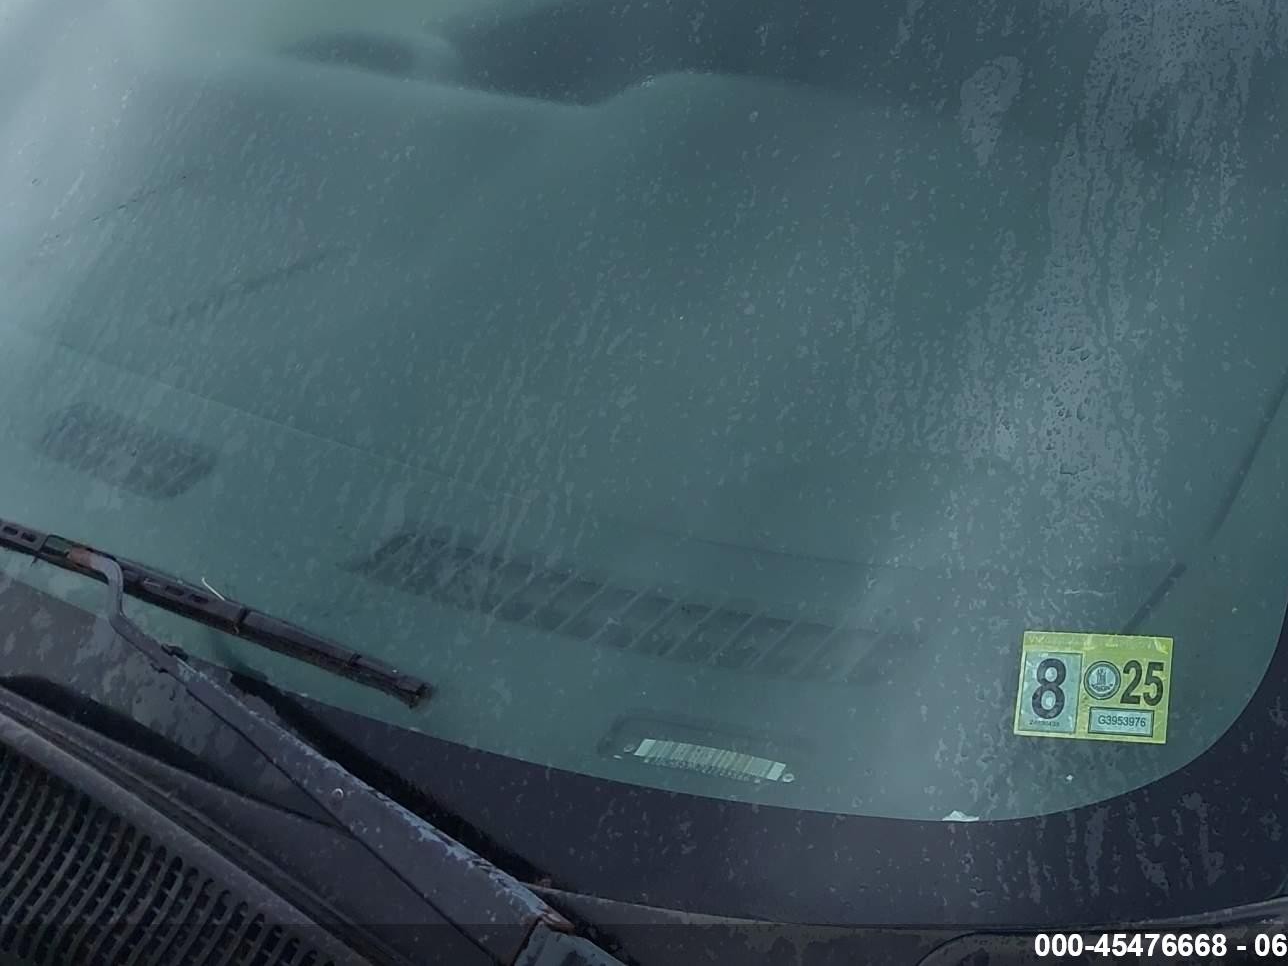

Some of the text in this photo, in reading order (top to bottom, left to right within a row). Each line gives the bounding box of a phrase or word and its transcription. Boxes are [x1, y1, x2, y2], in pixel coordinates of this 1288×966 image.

[1032, 658, 1067, 720] 8
[1120, 659, 1165, 707] 25
[1097, 714, 1147, 728] G3953976
